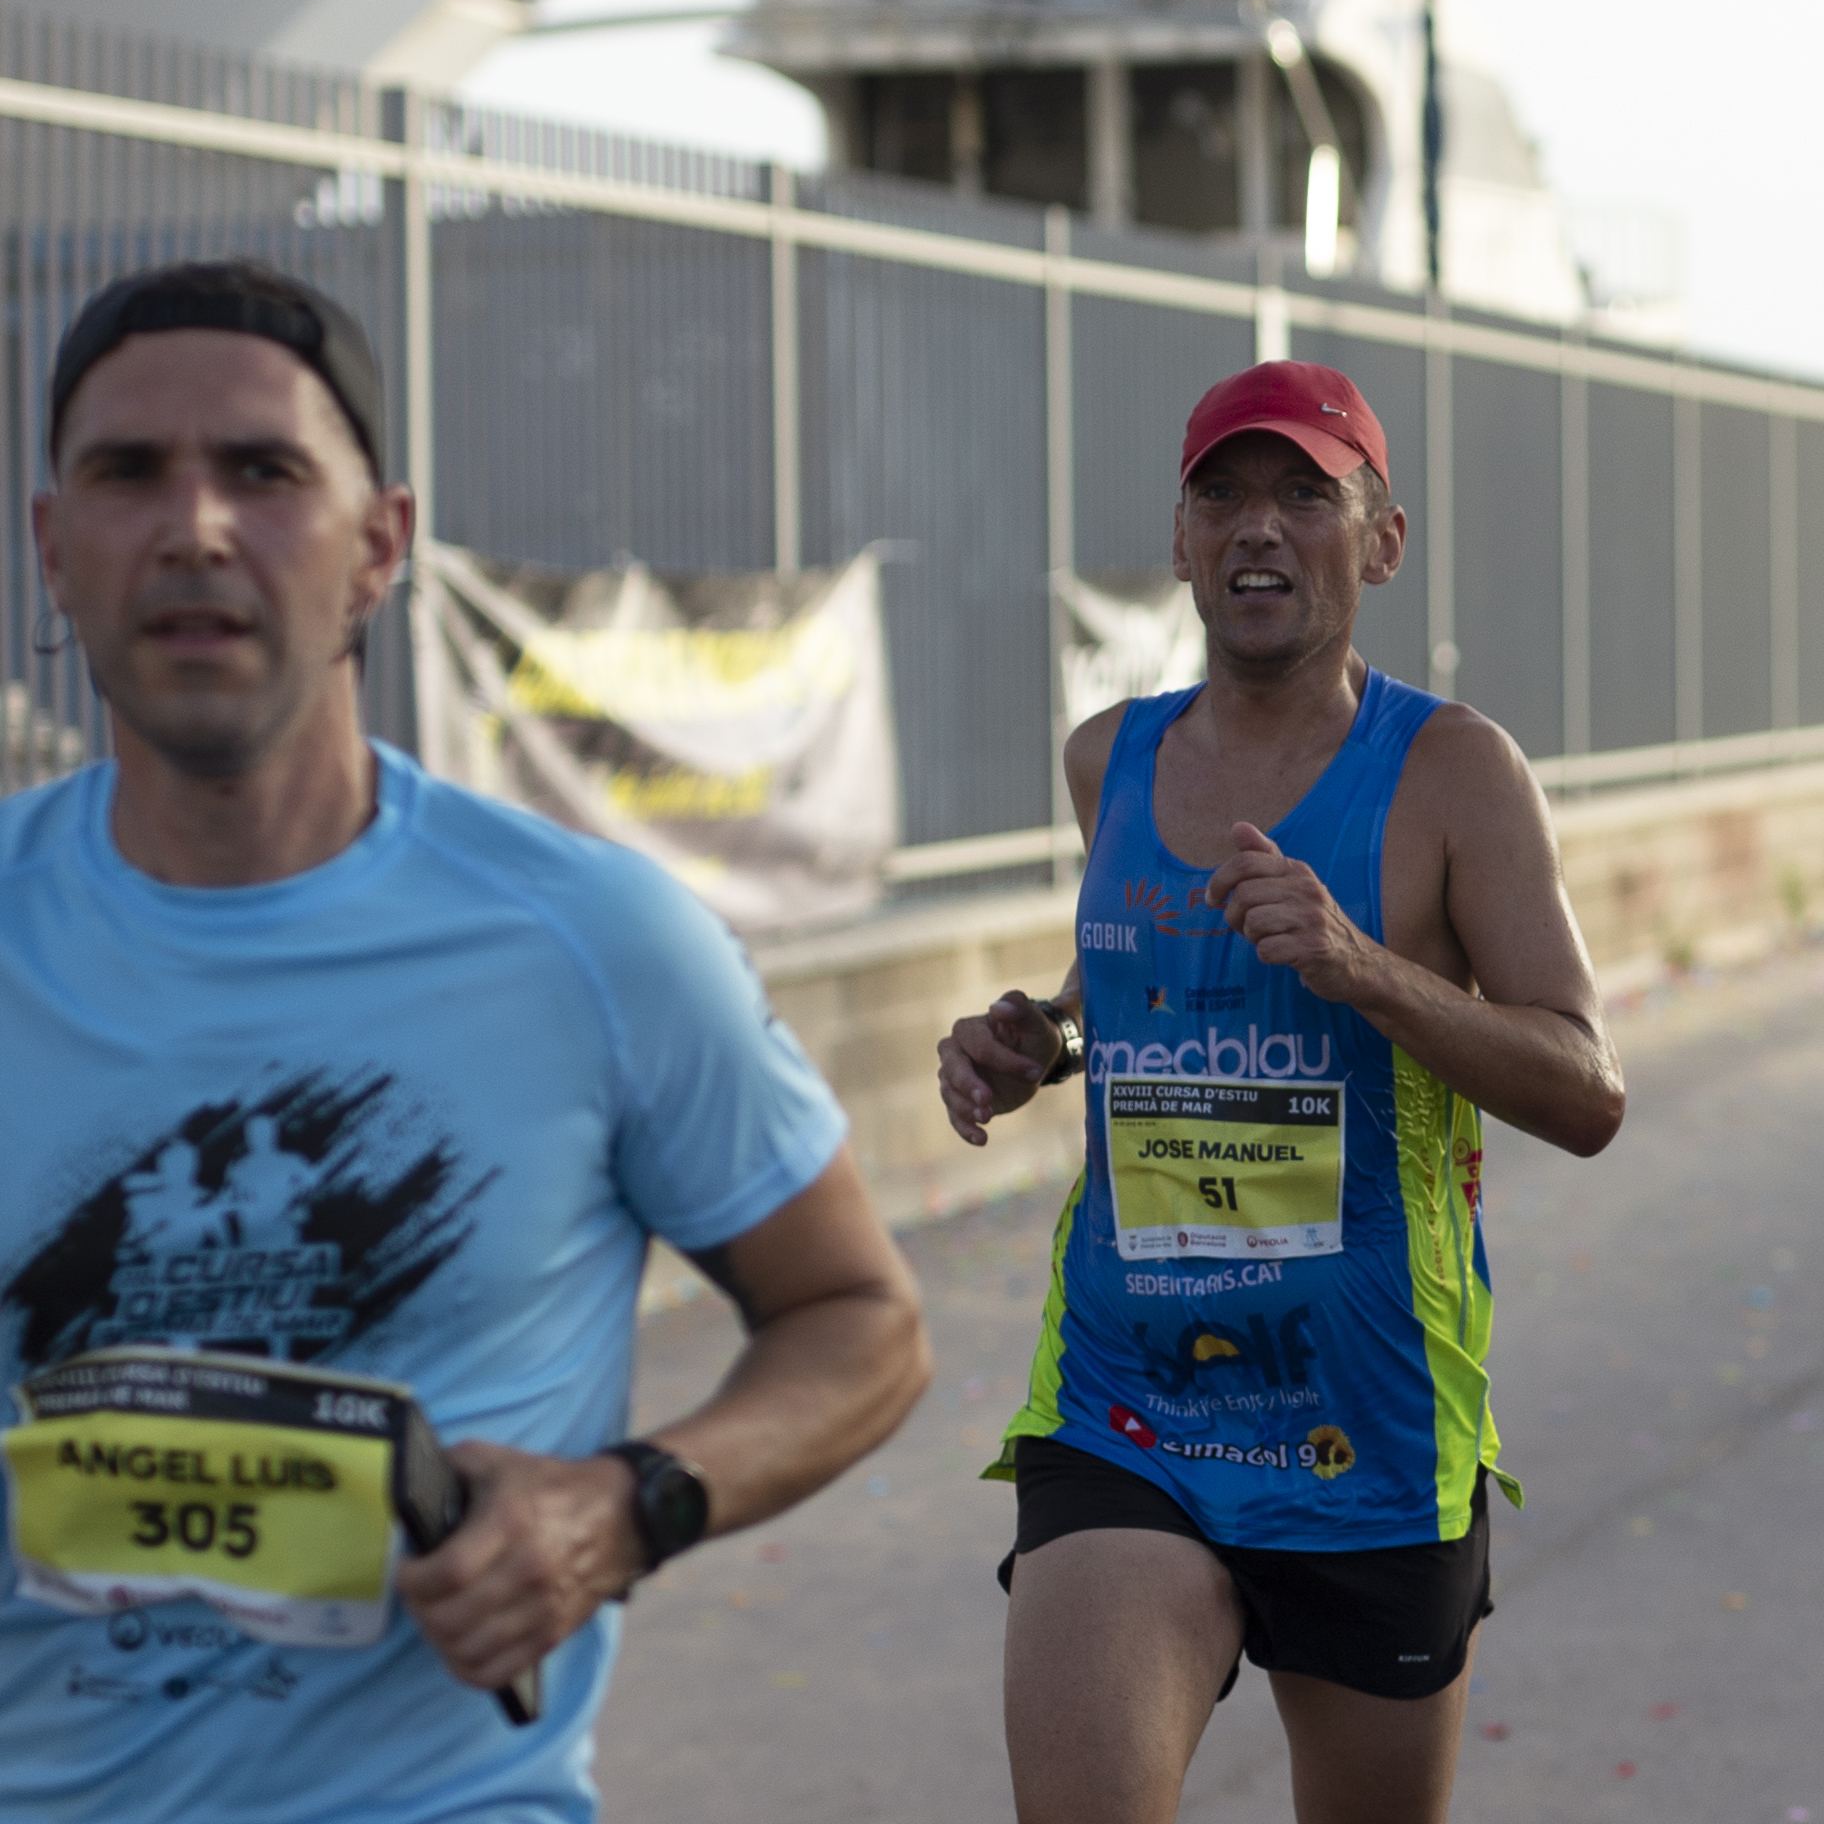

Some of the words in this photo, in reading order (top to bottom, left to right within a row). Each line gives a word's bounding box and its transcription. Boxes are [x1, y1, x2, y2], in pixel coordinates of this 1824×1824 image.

[1080, 921, 1139, 954] GOBIK
[1112, 1085, 1153, 1099] XXVIII
[1155, 1085, 1200, 1100] CURSA
[1112, 1097, 1158, 1113] PREMIÀ
[1161, 1101, 1178, 1113] DE
[1181, 1102, 1213, 1114] MAR
[1287, 1095, 1332, 1116] 10K
[1137, 1139, 1194, 1160] JOSE
[1197, 1141, 1305, 1163] MANUEL
[1197, 1175, 1240, 1211] 51
[311, 1390, 389, 1429] 10K
[56, 1438, 218, 1487] ANGEL
[229, 1452, 339, 1493] LUIS
[128, 1499, 260, 1559] 305
